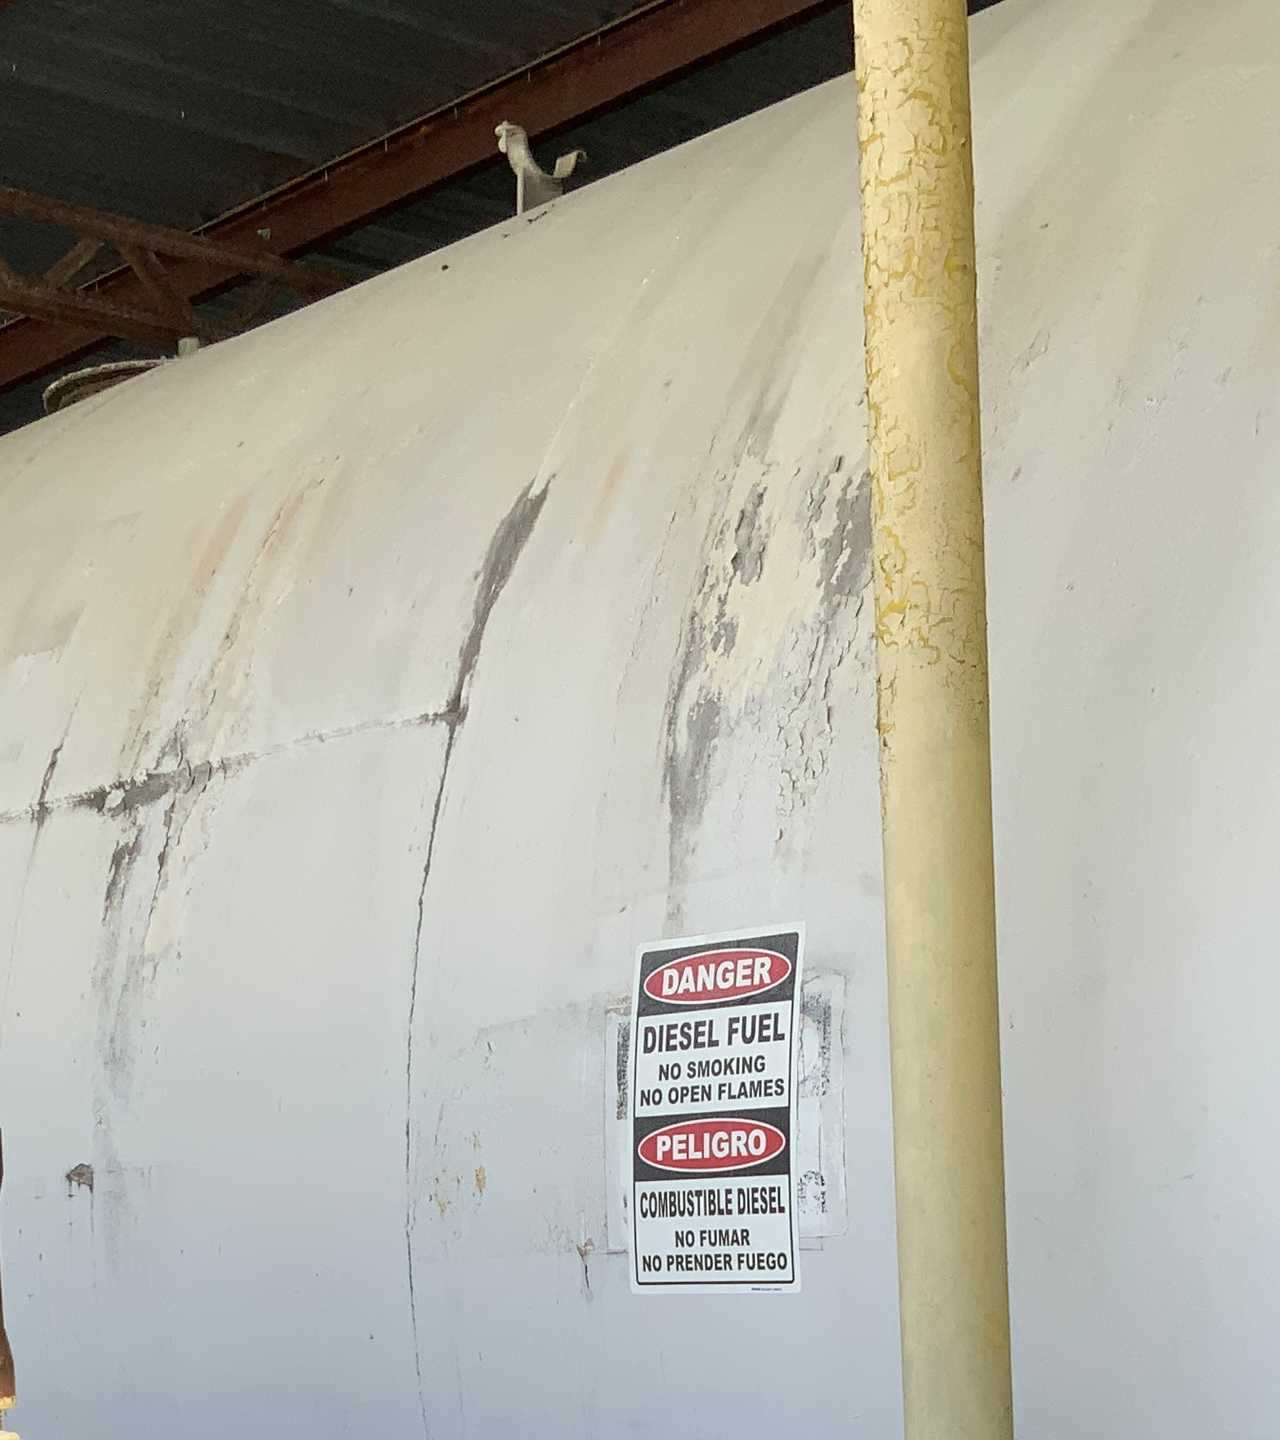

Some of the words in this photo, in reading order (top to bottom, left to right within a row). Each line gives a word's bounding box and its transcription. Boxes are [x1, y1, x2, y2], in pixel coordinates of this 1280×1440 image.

[662, 956, 772, 996] DANGER
[643, 1019, 719, 1054] DIESEL
[727, 1012, 785, 1046] FUEL
[658, 1063, 681, 1081] NO
[687, 1055, 766, 1079] SMOKING
[640, 1089, 662, 1107] NO
[668, 1083, 711, 1104] OPEN
[718, 1078, 785, 1100] FLAMES
[656, 1129, 767, 1161] PELIGRO
[640, 1188, 733, 1219] COMBUSTIBLE
[737, 1186, 785, 1215] DIESEL
[675, 1230, 694, 1248] NO
[700, 1228, 750, 1247] FUMAR
[642, 1255, 662, 1272] NO
[666, 1253, 732, 1272] PRENDER
[737, 1252, 787, 1271] FUEGO
